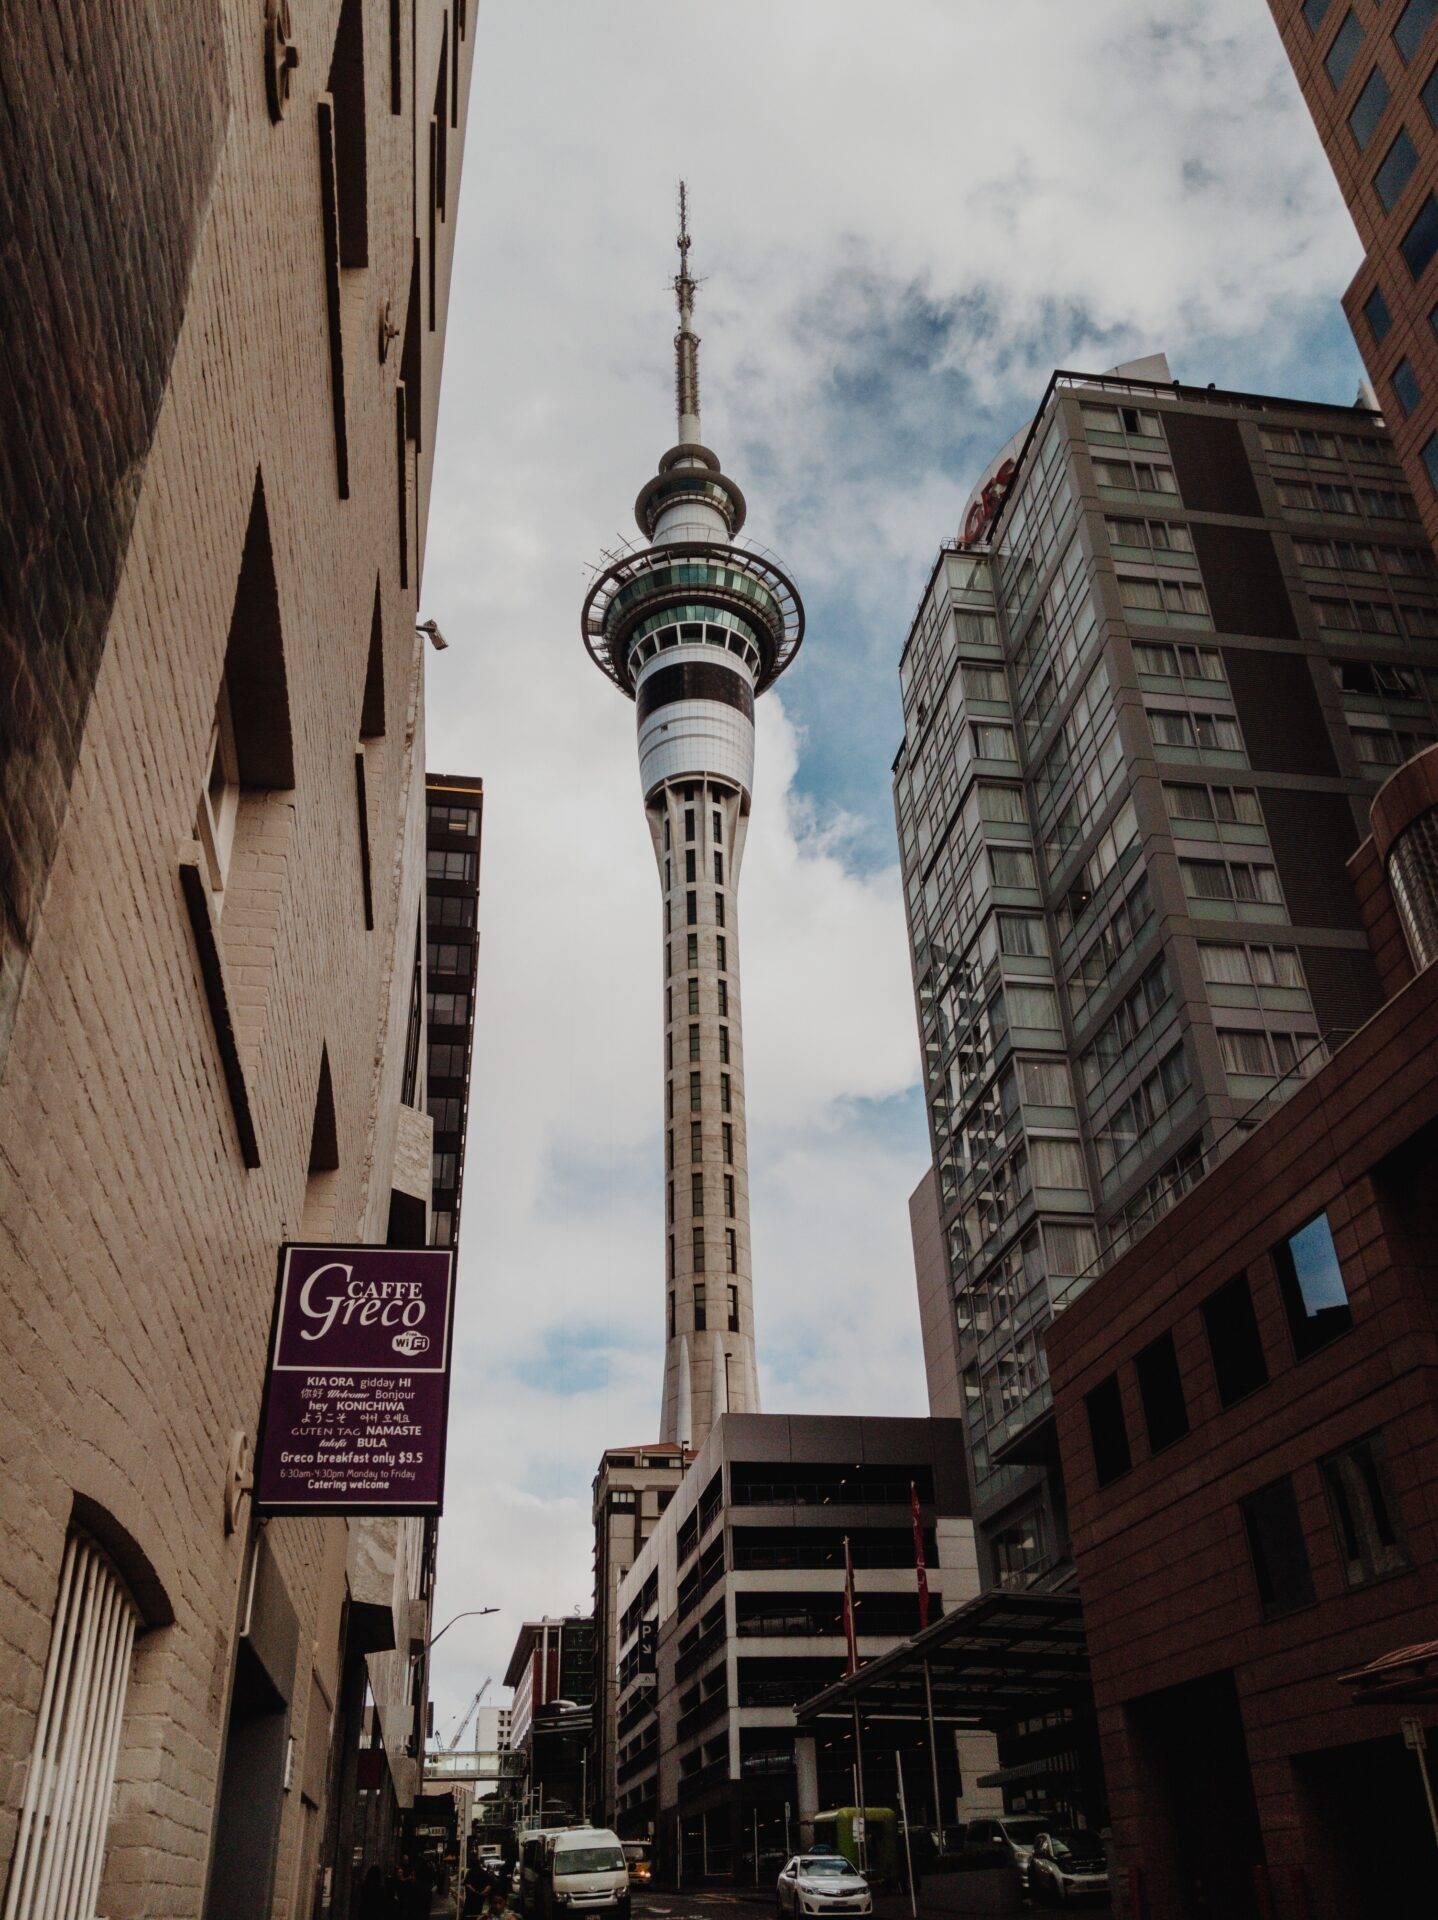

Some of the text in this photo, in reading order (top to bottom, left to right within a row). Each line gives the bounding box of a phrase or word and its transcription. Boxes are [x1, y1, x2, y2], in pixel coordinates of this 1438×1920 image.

[347, 1281, 422, 1299] CAFFE
[300, 1263, 426, 1340] Greco
[307, 1377, 411, 1389] KIA ORA gidday HI
[301, 1388, 324, 1399] 你好
[327, 1389, 416, 1400] Welcome Bonjour
[308, 1401, 405, 1412] hey KONICHIWA
[301, 1412, 347, 1423] ようこそ
[291, 1425, 422, 1436] GUTEN TAG NAMASTE
[356, 1438, 388, 1448] BULA
[280, 1452, 314, 1463] Greco
[316, 1452, 369, 1463] breakfast
[372, 1452, 395, 1466] only
[346, 1469, 379, 1481] Monday
[380, 1469, 389, 1479] to
[391, 1469, 416, 1481] Friday
[307, 1479, 390, 1491] Catering welcome
[642, 1625, 652, 1638] P
